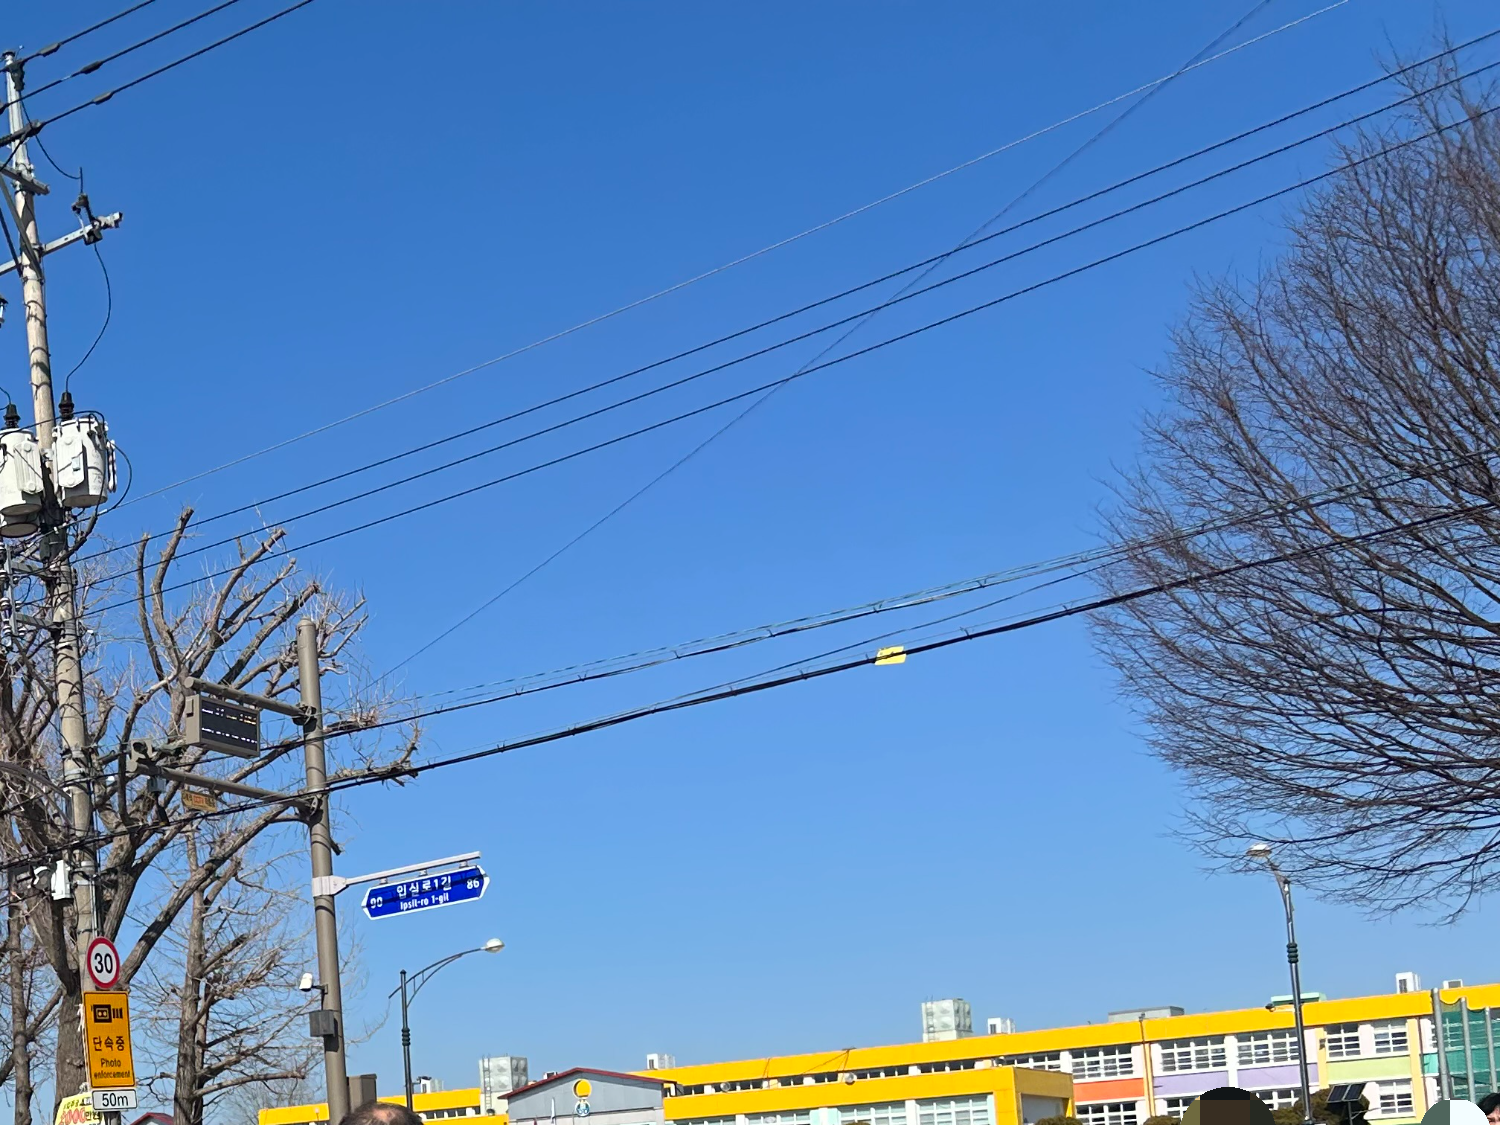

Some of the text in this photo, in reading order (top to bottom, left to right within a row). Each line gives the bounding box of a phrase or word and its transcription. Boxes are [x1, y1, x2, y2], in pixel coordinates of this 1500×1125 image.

[370, 875, 480, 909] 90 입실로1길 86
[400, 898, 429, 911] Ipsil-ro
[94, 952, 113, 974] 30
[93, 1035, 125, 1052] 단속중
[100, 1058, 122, 1068] Photo
[94, 1070, 130, 1080] enforcement
[102, 1092, 128, 1108] 50m
